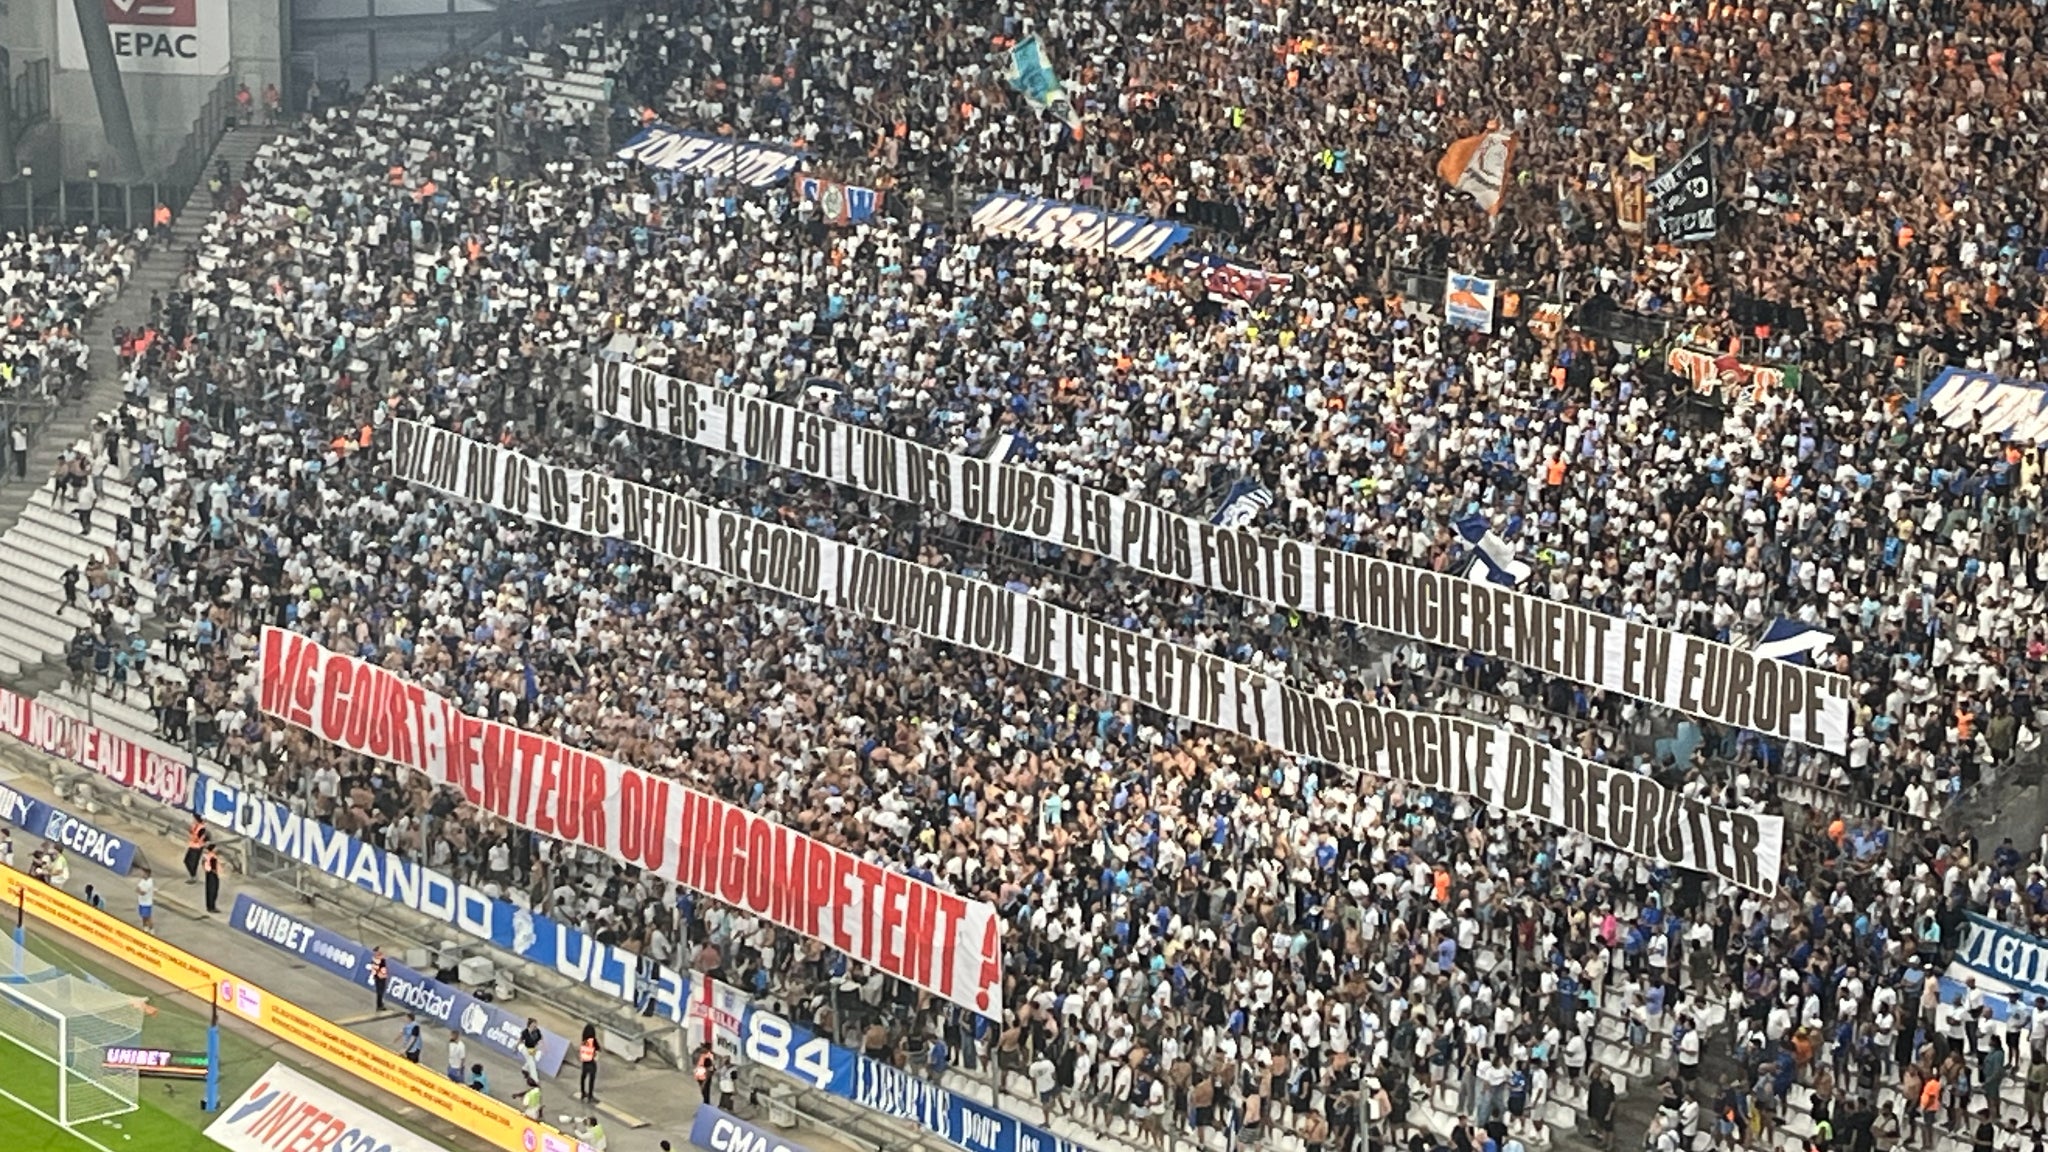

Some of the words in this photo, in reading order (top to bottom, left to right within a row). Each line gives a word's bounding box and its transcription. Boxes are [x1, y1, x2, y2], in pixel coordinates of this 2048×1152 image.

[115, 32, 198, 59] EPAC
[790, 410, 836, 478] EST
[846, 425, 897, 496] L'UN
[906, 441, 951, 512] DES
[962, 459, 1055, 537] CLUBS
[1063, 483, 1112, 556] LES
[1122, 499, 1192, 579] PLUS
[1200, 523, 1302, 607] FORTS
[1315, 549, 1611, 684] FINANCIEREMENT
[1623, 621, 1671, 703] EN
[1679, 636, 1847, 746] EUROPE"
[395, 420, 461, 492] BILAN
[465, 442, 497, 504] AU
[623, 479, 709, 564] DEFICIT
[719, 511, 828, 608] RECORD,
[836, 544, 1015, 656] LIQUIDATION
[1024, 599, 1057, 672] DE
[1066, 612, 1225, 724] L'EFFECTIF
[1235, 666, 1267, 742] ET
[1279, 683, 1496, 801] INCAPACITE
[1503, 734, 1551, 818] DE
[1563, 754, 1774, 895] RECRUTER.
[61, 817, 122, 867] CEPAC
[441, 699, 607, 849] MENTEUR
[619, 769, 669, 871] OU
[677, 790, 967, 997] INCOMPETENT
[204, 777, 493, 940] COMMANDO
[556, 924, 691, 1029] ULTR
[745, 1009, 834, 1090] 84
[244, 903, 315, 954] UNIBET
[386, 975, 455, 1021] randstad
[106, 1047, 172, 1067] UNIBET
[962, 1107, 1002, 1148] pour
